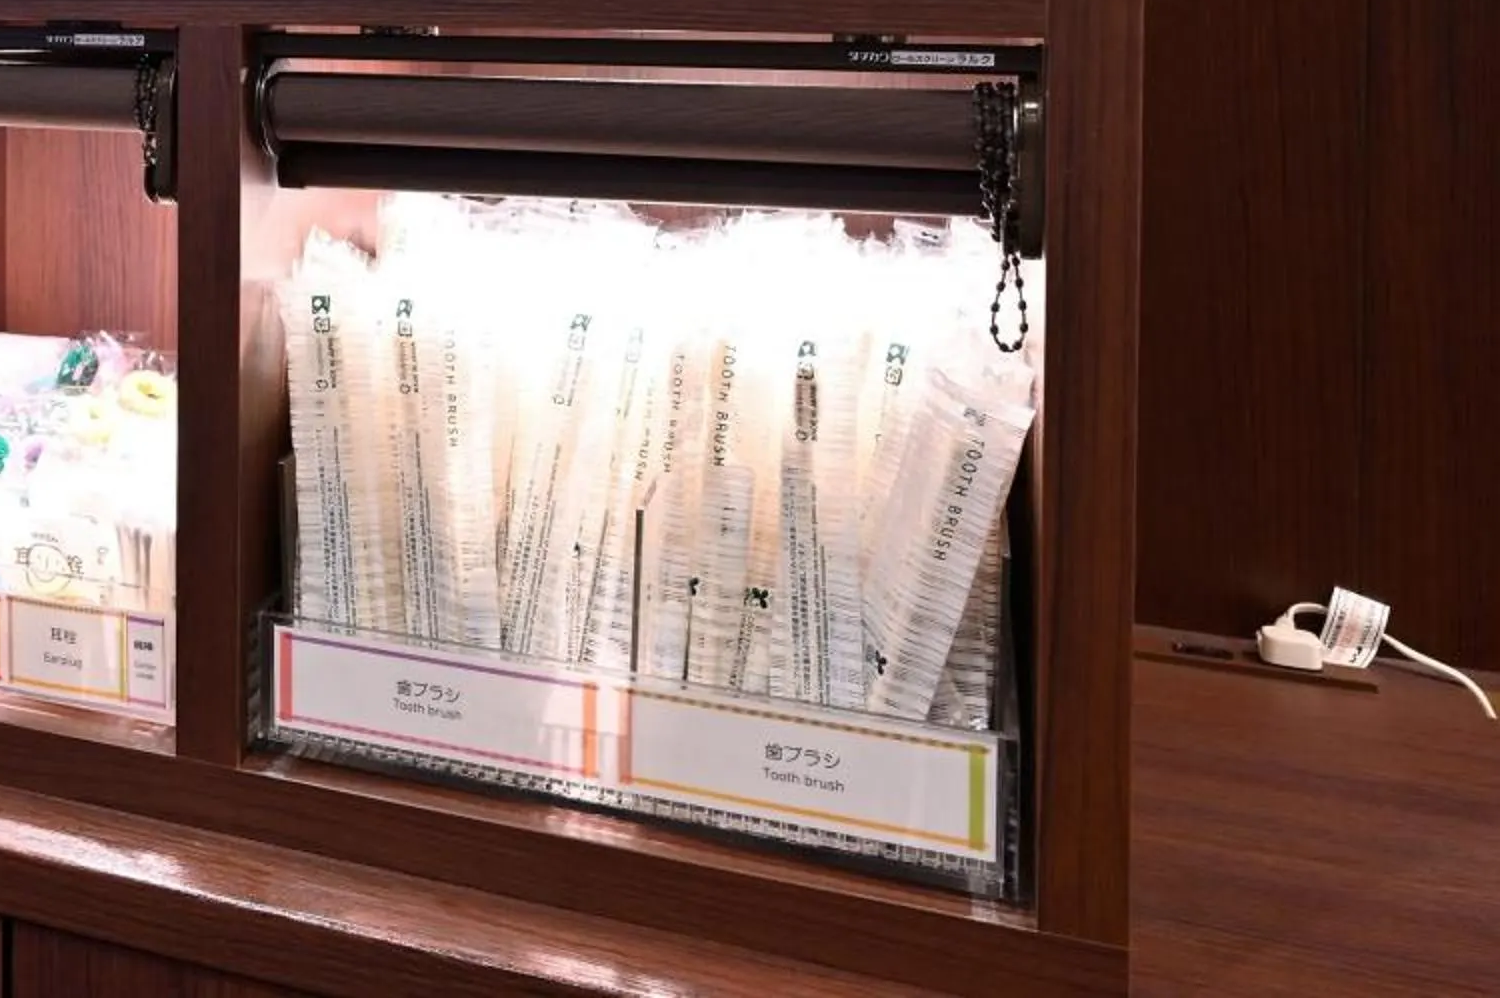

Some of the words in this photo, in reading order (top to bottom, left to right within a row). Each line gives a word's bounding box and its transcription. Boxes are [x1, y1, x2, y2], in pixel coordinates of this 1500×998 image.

[671, 354, 685, 411] TOOTH
[718, 345, 737, 402] TOOTH
[713, 411, 729, 467] BRUSH
[955, 439, 985, 498] TOOTH
[933, 505, 962, 561] BRUSH
[393, 697, 426, 714] Tooth
[427, 703, 463, 720] brush
[397, 680, 460, 703] 歯ブラシ
[762, 767, 800, 784] Tooth
[803, 773, 845, 794] brush
[765, 742, 840, 769] 歯ブラシ
